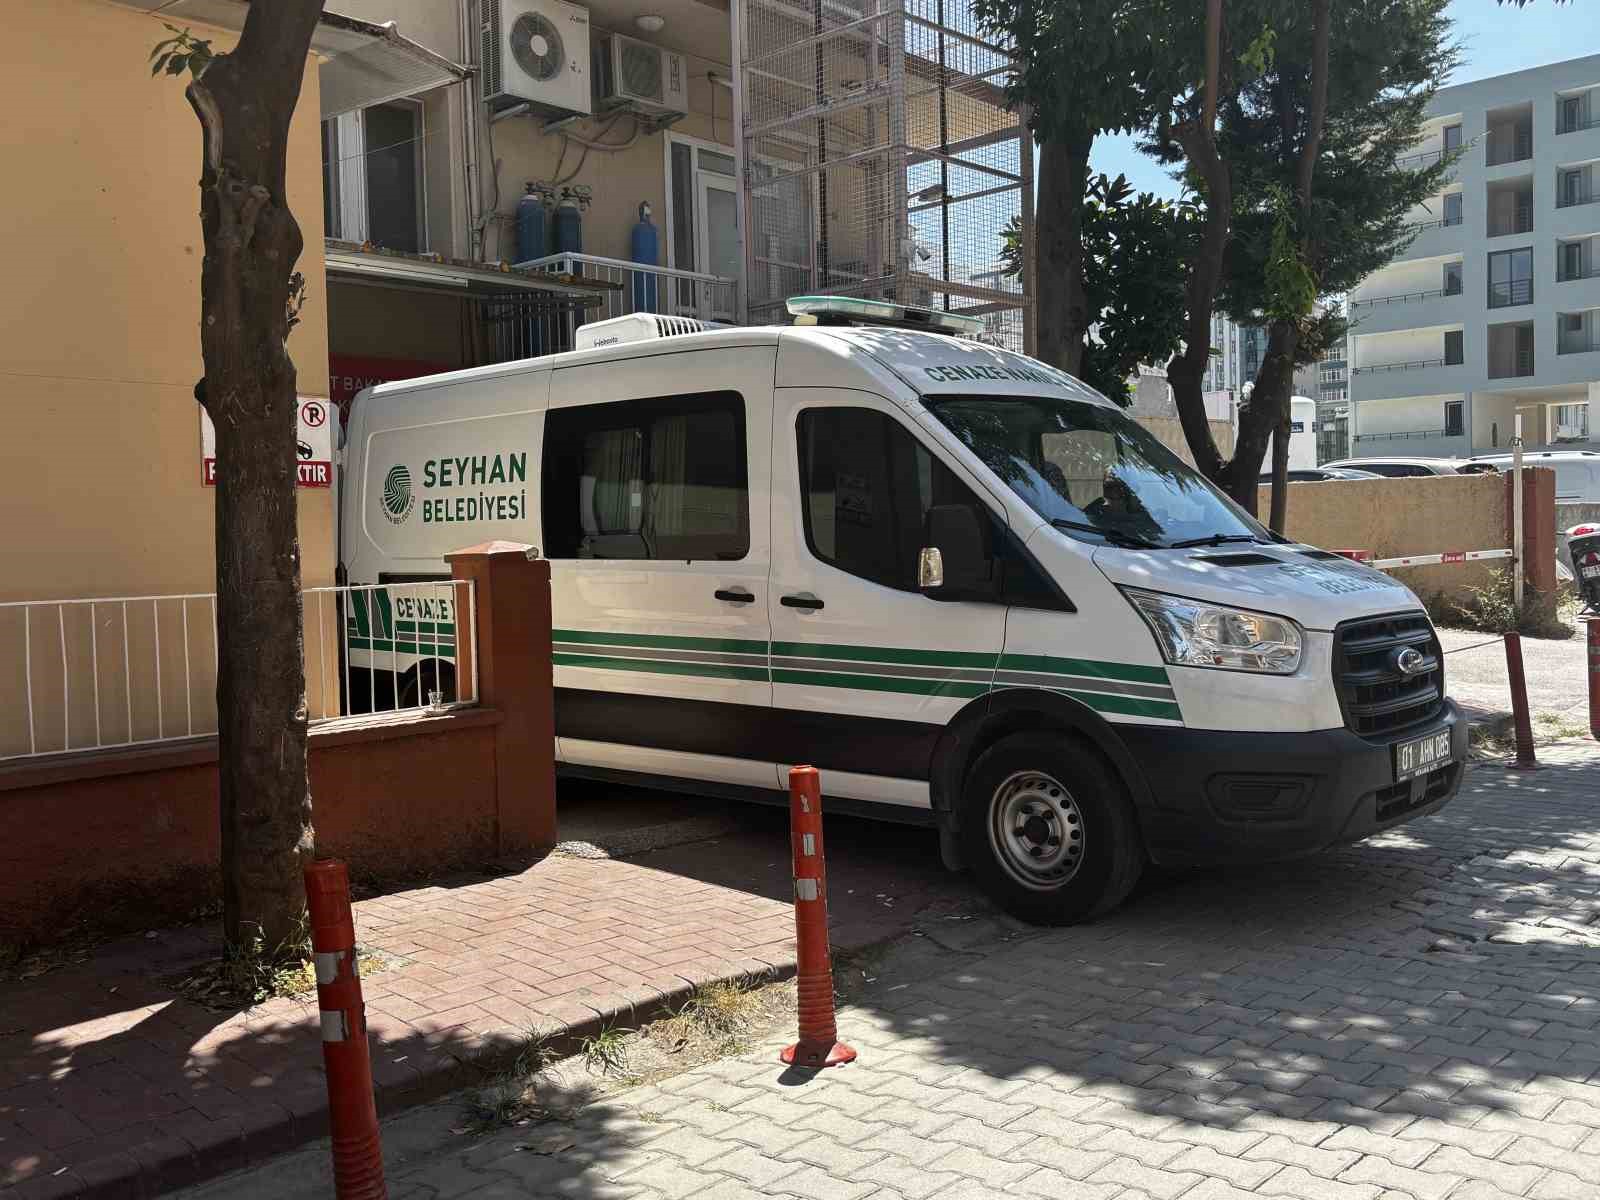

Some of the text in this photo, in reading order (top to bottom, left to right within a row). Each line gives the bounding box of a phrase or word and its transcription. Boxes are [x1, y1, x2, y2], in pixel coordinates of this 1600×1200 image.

[925, 366, 1007, 382] CENAZE
[297, 464, 327, 482] KTIR
[423, 452, 527, 488] SEYHAN
[423, 489, 526, 523] BELEDİYESİ
[1402, 744, 1413, 770] 01
[1435, 732, 1449, 759] 085
